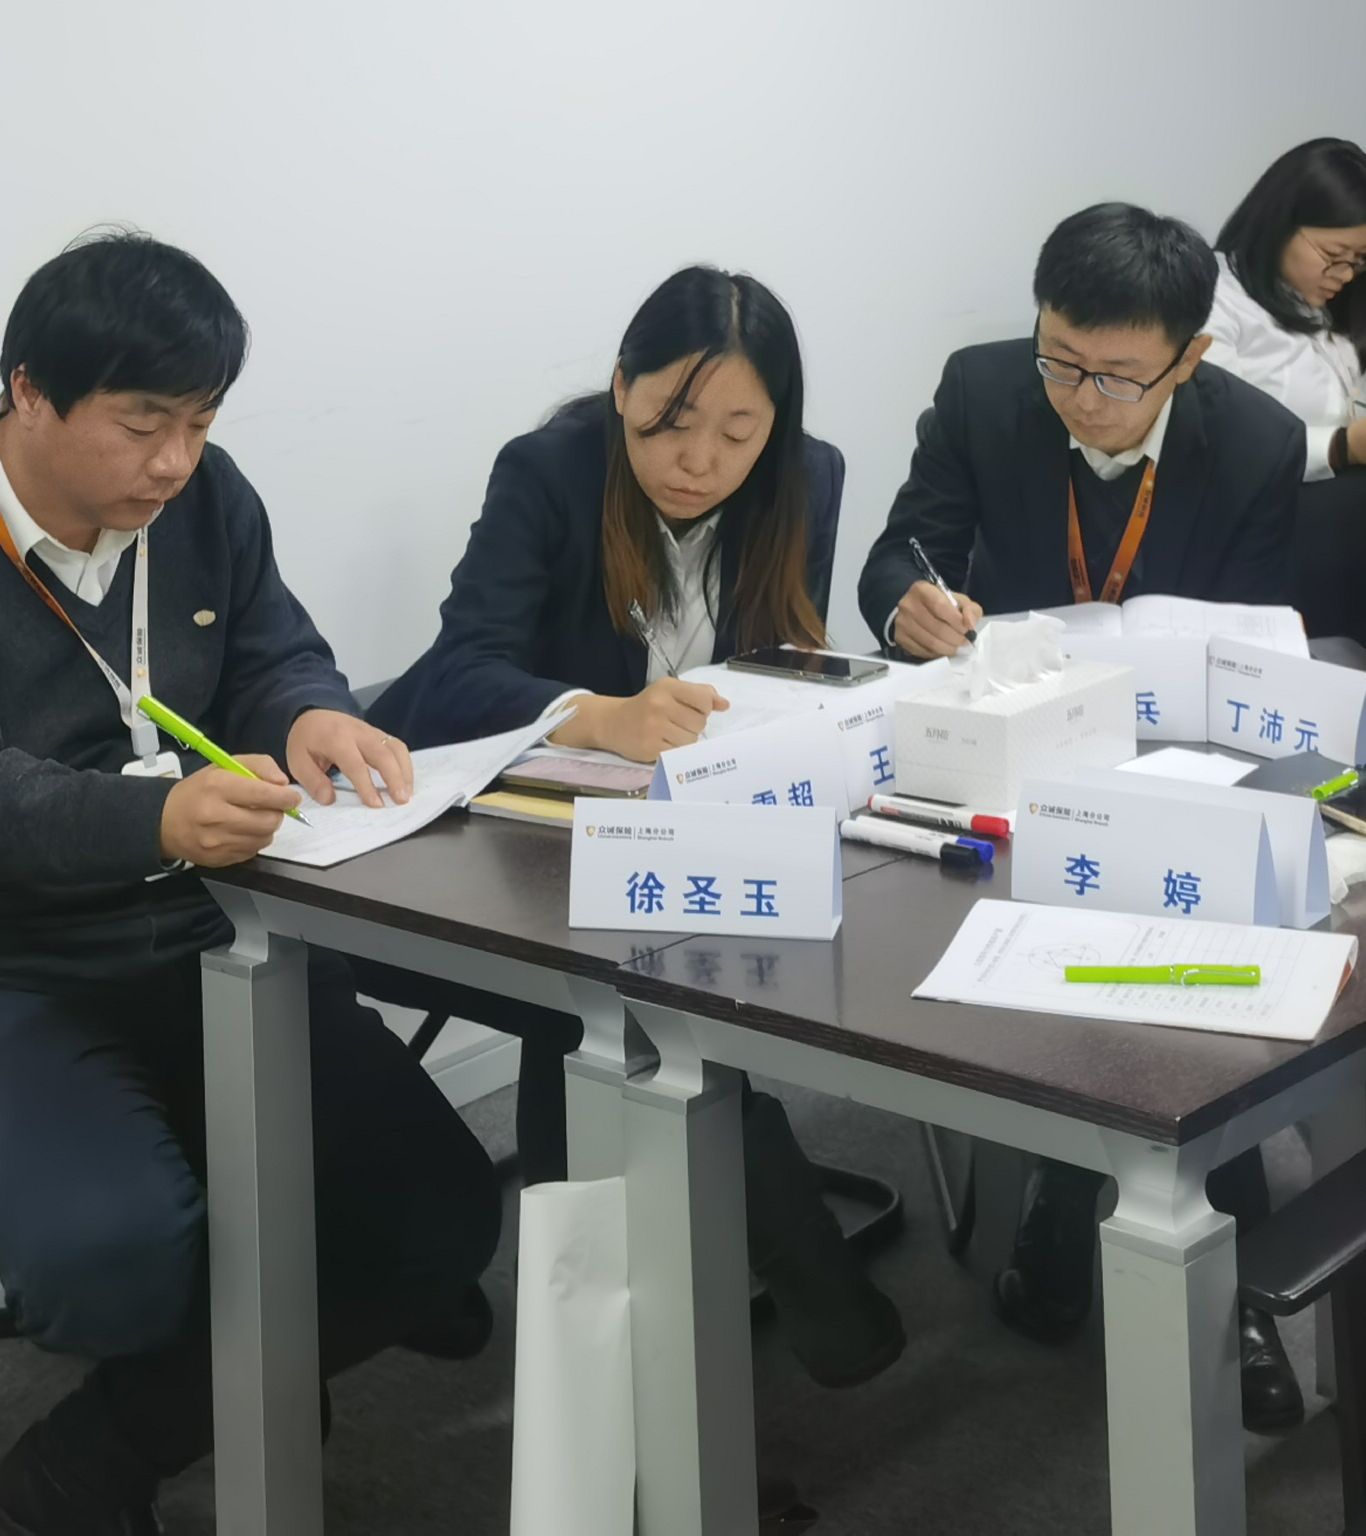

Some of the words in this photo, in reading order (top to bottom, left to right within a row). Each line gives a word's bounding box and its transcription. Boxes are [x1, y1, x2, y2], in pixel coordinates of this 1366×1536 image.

[1226, 698, 1319, 752] 丁沛元
[625, 870, 780, 918] 徐圣玉
[1063, 853, 1202, 915] 李婷
